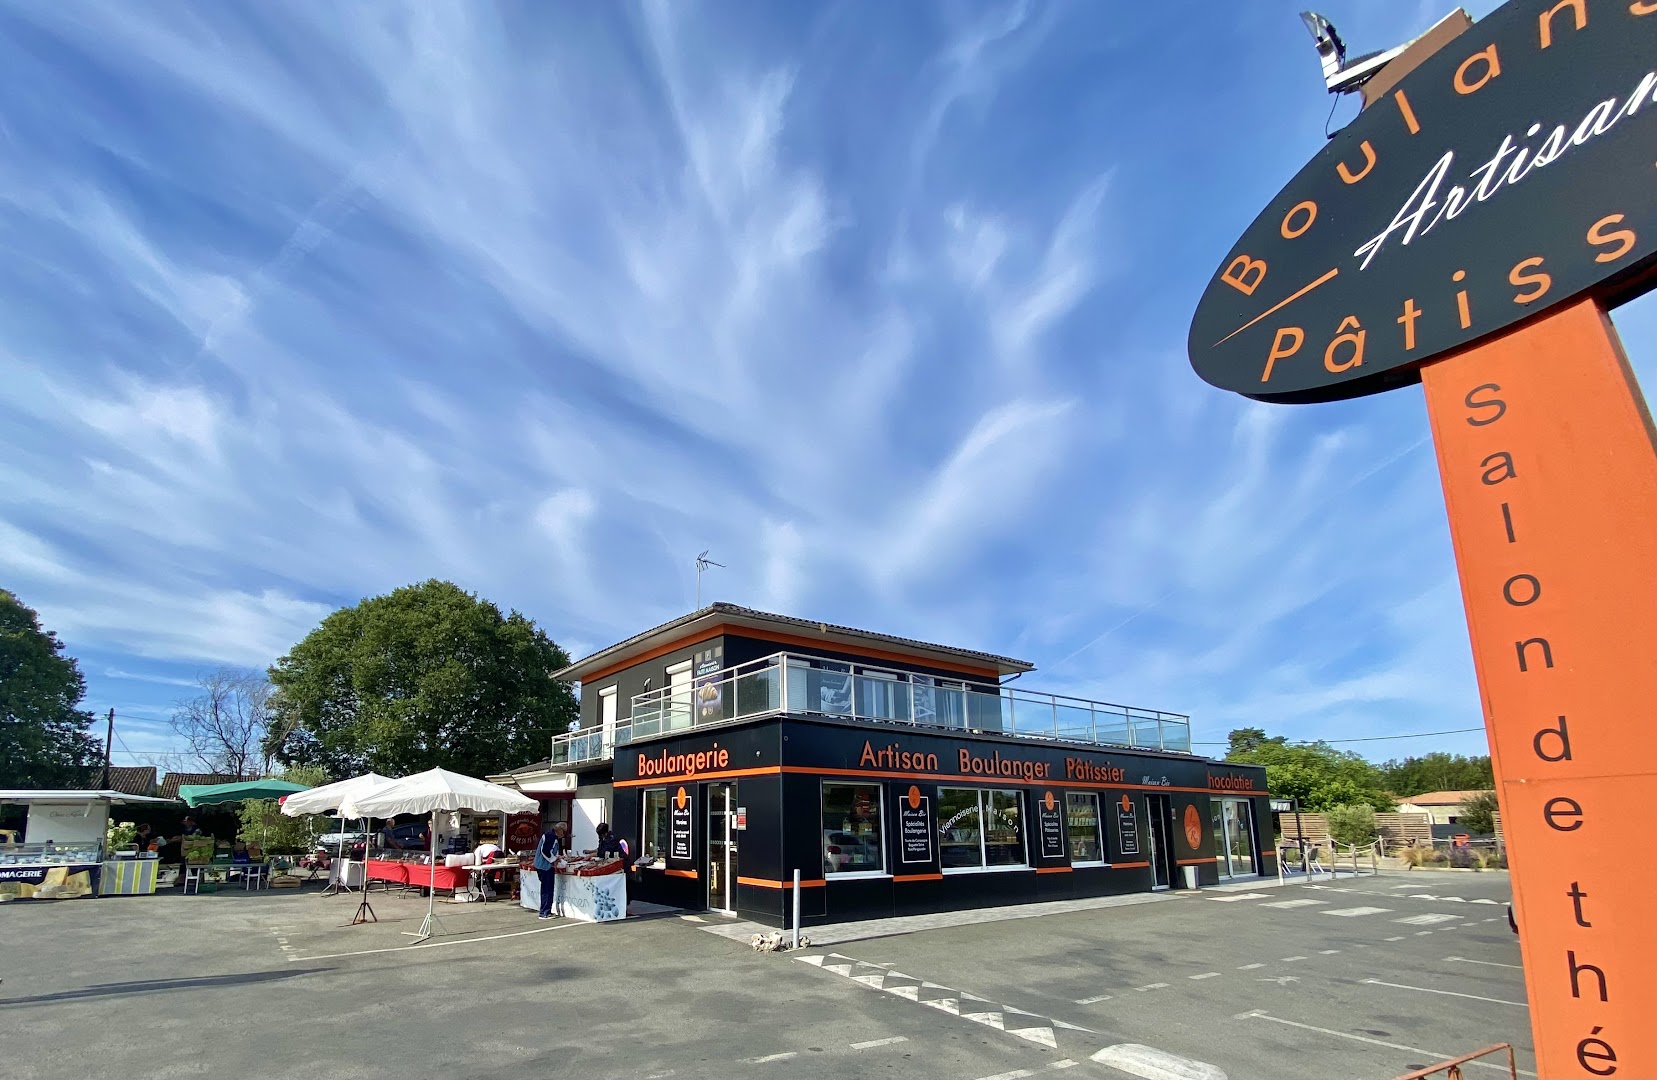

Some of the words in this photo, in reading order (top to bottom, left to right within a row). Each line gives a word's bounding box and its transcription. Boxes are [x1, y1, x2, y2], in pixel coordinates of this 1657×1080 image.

[1261, 211, 1640, 382] Pâtiss
[638, 742, 729, 777] Boulangerie
[860, 740, 938, 770] Artisan
[958, 748, 1050, 781] Boulanger
[1065, 757, 1125, 782] Pâtissier
[1207, 770, 1254, 790] hocolatier
[939, 804, 979, 834] Viennoiserie
[985, 804, 1019, 833] Maison
[0, 870, 42, 878] MAGERIE
[1533, 715, 1583, 832] de
[1566, 881, 1617, 1076] thé
